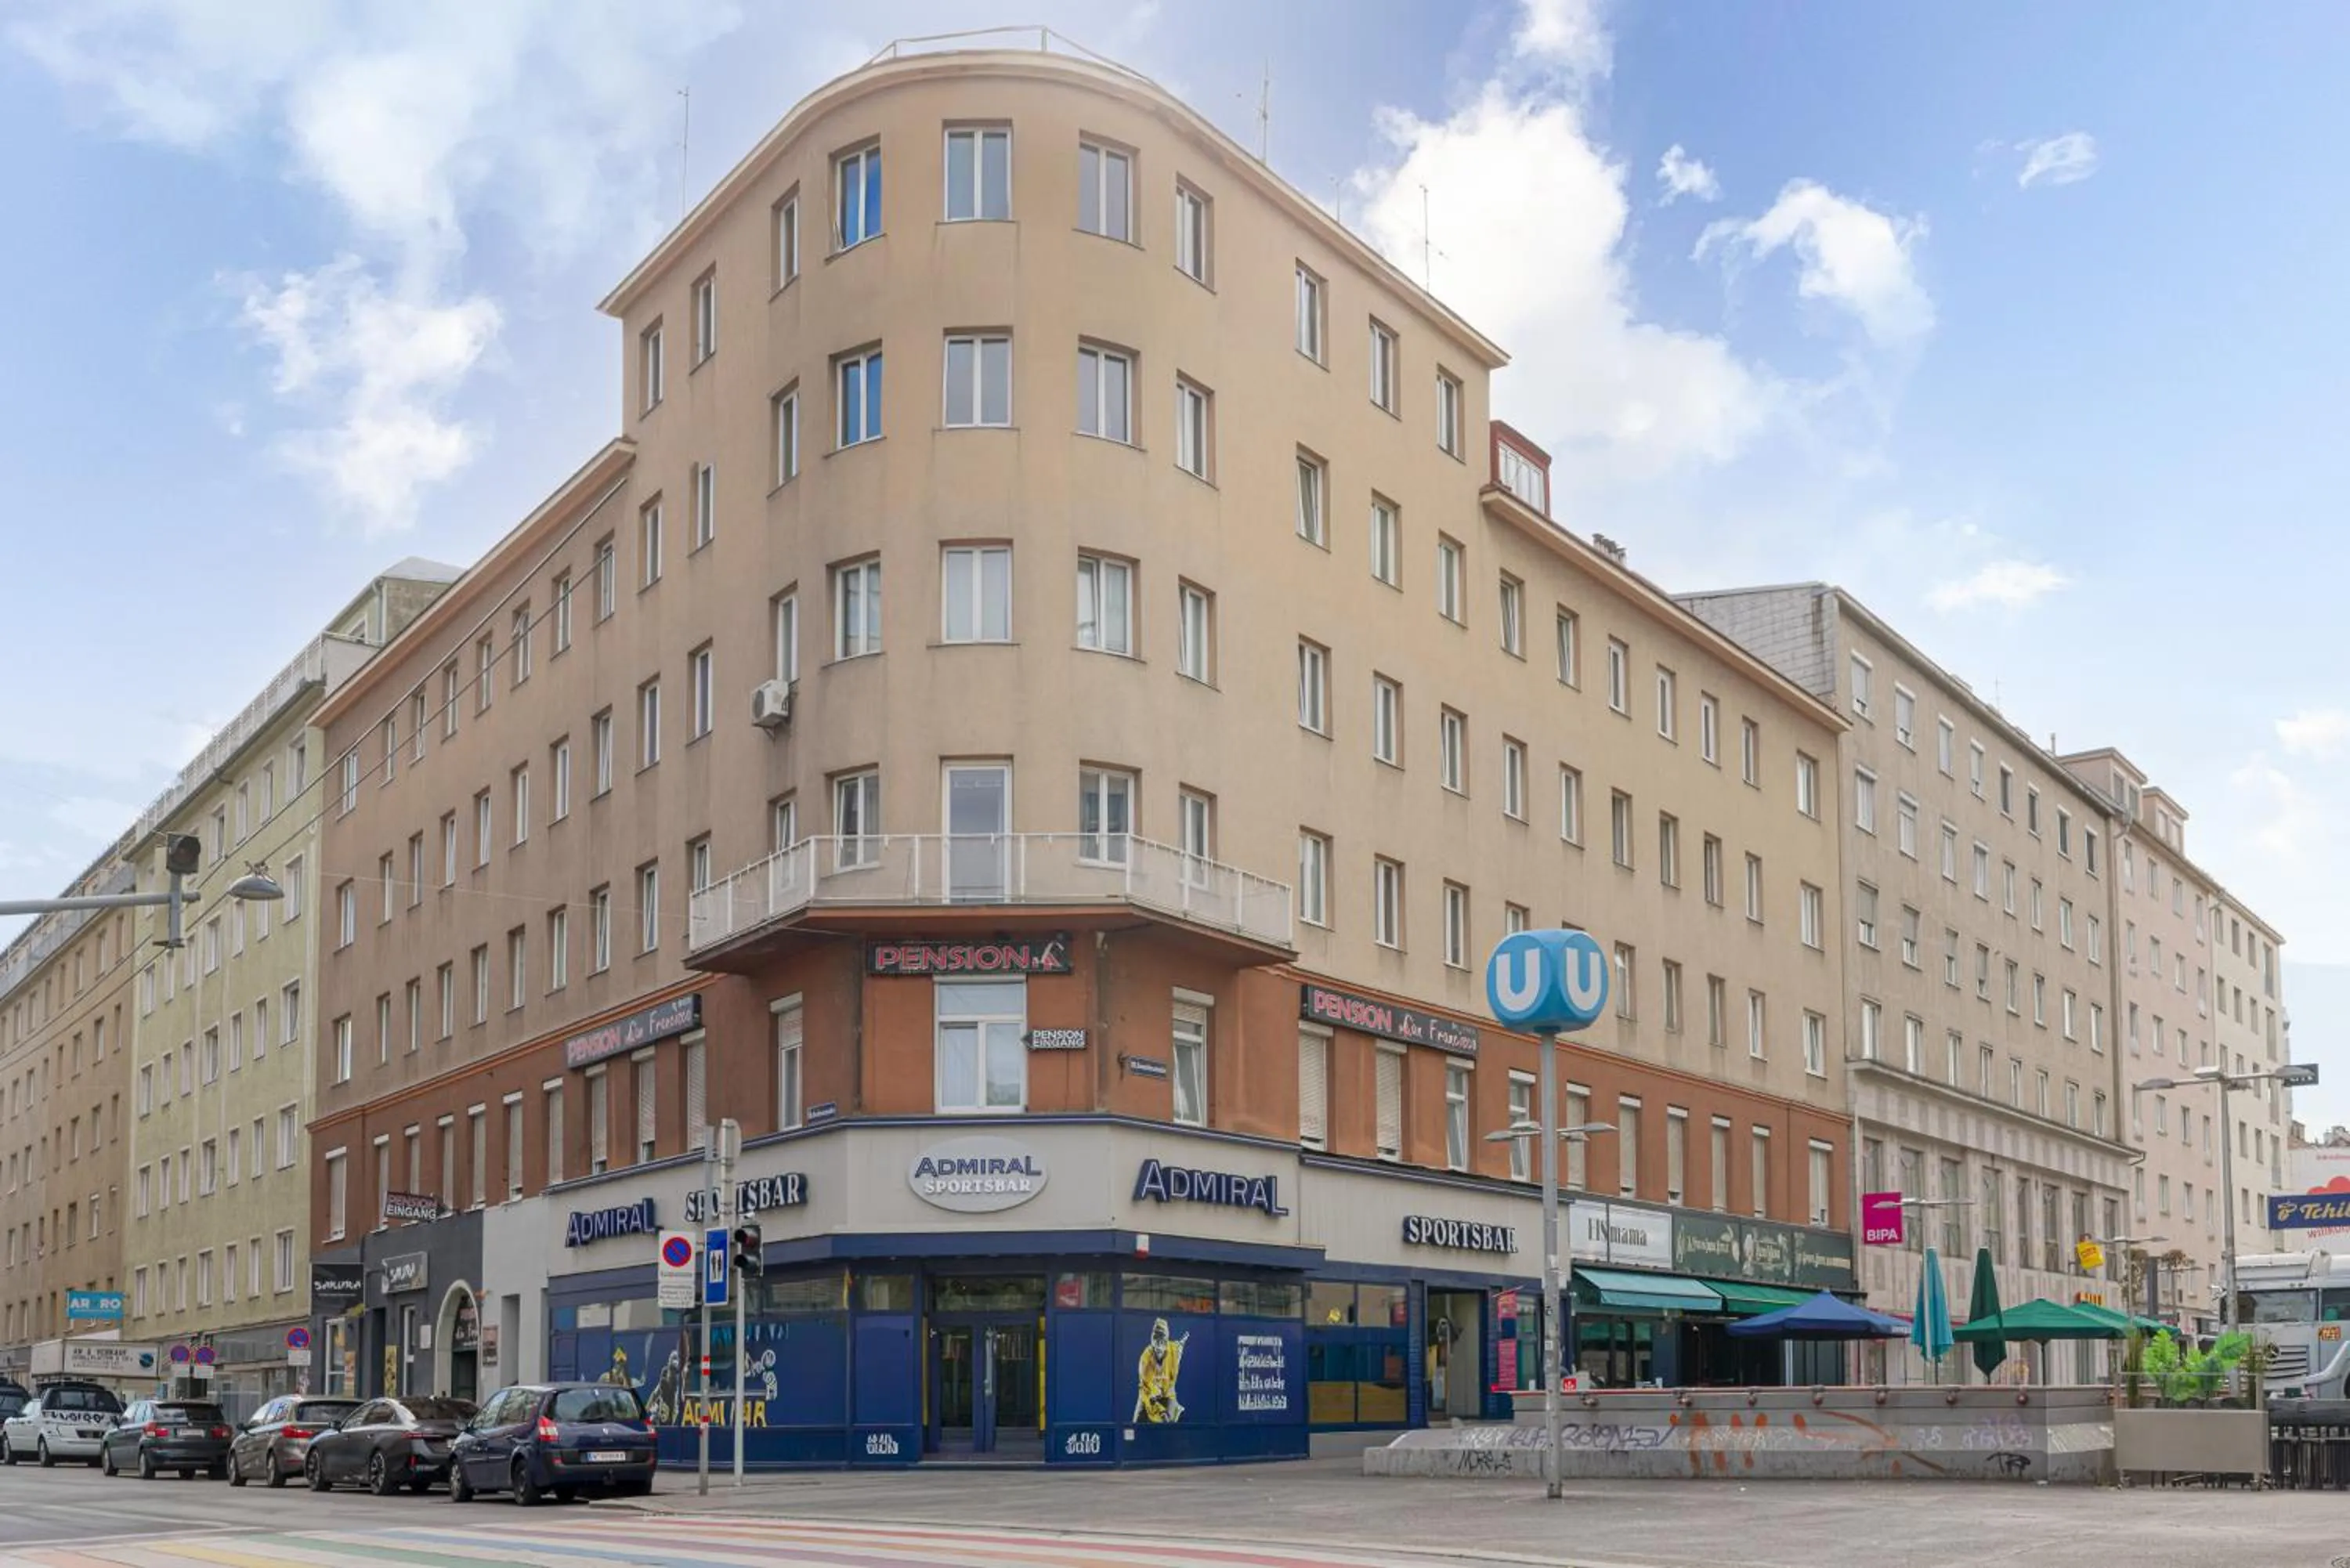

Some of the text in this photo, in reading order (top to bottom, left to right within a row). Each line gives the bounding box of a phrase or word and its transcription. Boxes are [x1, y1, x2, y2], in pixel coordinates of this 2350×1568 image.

[874, 944, 1030, 970] PENSION
[1495, 948, 1540, 1012] U
[1567, 948, 1602, 1011] U
[1314, 989, 1392, 1033] PENSION
[567, 1026, 621, 1062] PENSION
[1032, 1029, 1085, 1040] PENSION
[1032, 1039, 1085, 1048] EINGANG
[914, 1155, 1043, 1178] ADMIRAL
[924, 1178, 1031, 1194] SPORTSBAR
[1133, 1159, 1289, 1216] ADMIRAL
[386, 1205, 436, 1219] EINGANG
[388, 1194, 438, 1208] PENSION
[565, 1173, 808, 1248] ADMIRAL SPOTSBAR
[1404, 1216, 1518, 1253] SPORTSBAR
[1867, 1228, 1899, 1241] BIPA
